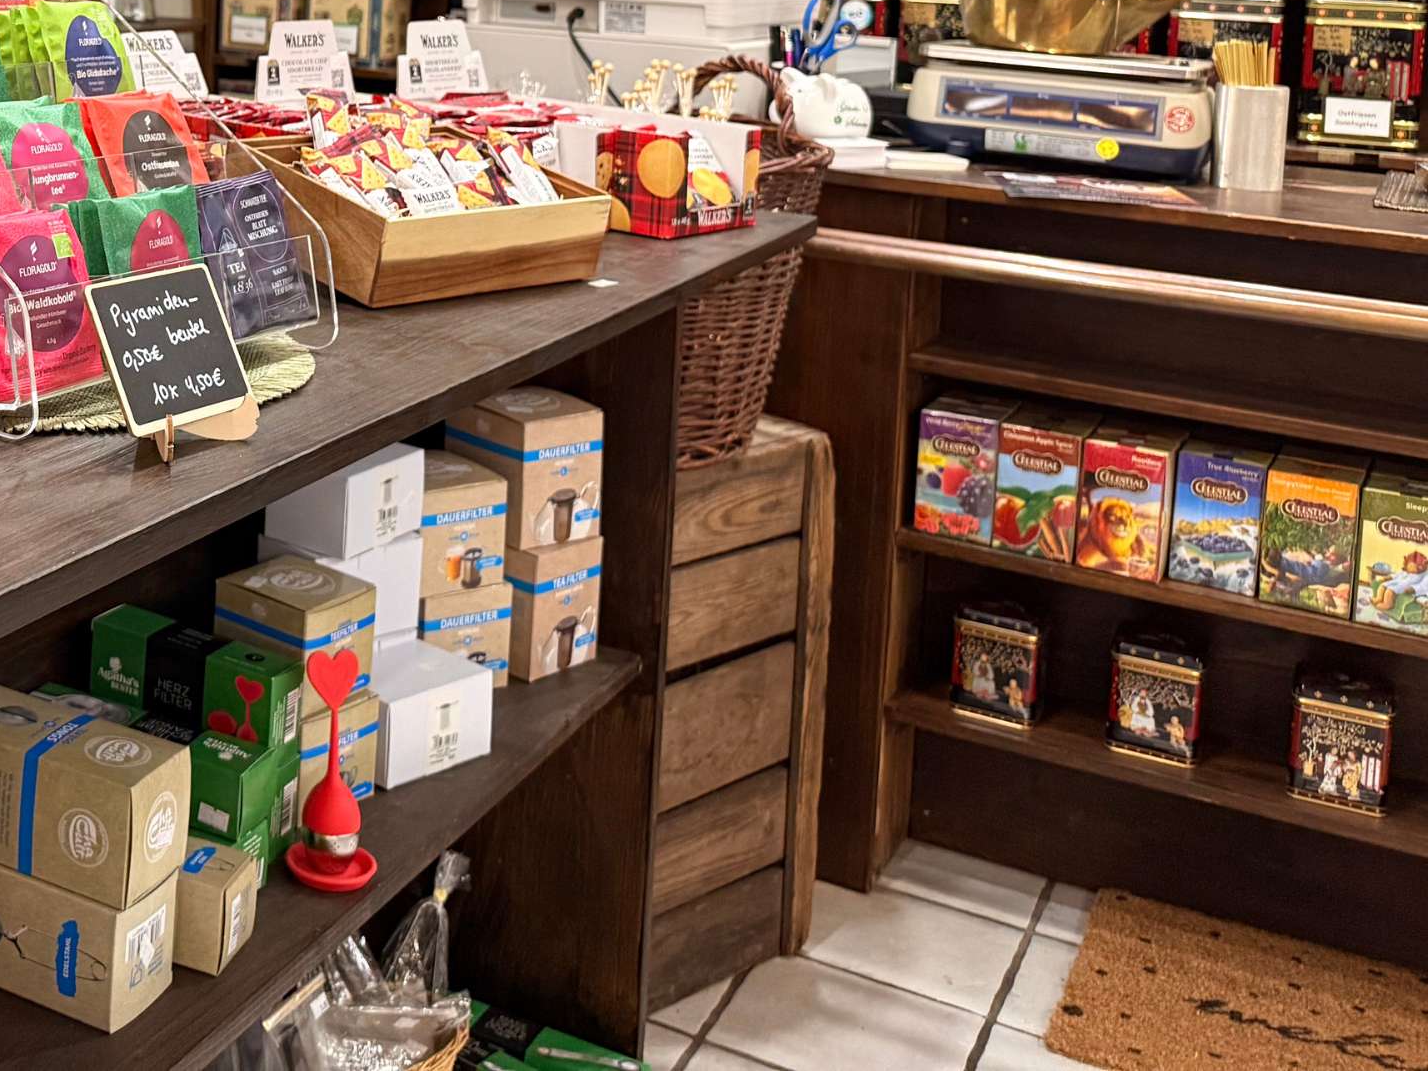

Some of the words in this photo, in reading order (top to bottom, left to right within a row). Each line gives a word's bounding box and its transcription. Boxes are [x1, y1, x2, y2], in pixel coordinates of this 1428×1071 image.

[284, 31, 326, 48] WALKER'S
[420, 32, 459, 49] WALKER'S
[31, 143, 63, 155] FLORAGOLD
[698, 208, 732, 226] WALKER'S
[247, 225, 279, 241] MISCHUNG
[18, 261, 56, 278] FLORAGOLD
[227, 262, 247, 275] TEA
[232, 279, 254, 294] 1836
[27, 292, 74, 310] Waldkobold
[109, 290, 199, 337] Pyramiden-
[166, 318, 210, 346] beutel
[153, 382, 179, 406] 10x
[185, 368, 225, 398] 4,50€
[538, 441, 591, 461] DAUERFILTER
[934, 438, 978, 455] CELESTIAL
[1015, 453, 1060, 472] CELESTIAL
[1207, 461, 1223, 472] True
[1224, 465, 1259, 478] Blueberry
[1098, 470, 1146, 490] CELESTIAL
[1194, 482, 1243, 502] CELESTIAL
[436, 505, 493, 526] DAUERFILTER
[1284, 502, 1334, 522] CELESTIAL
[553, 575, 568, 591] TEA
[569, 569, 589, 586] FILTER
[440, 609, 498, 629] DAUERFILTER
[330, 621, 358, 642] TEEFILTER
[97, 666, 140, 688] Agatha's
[157, 678, 190, 695] HERZ
[153, 688, 192, 711] FILTER
